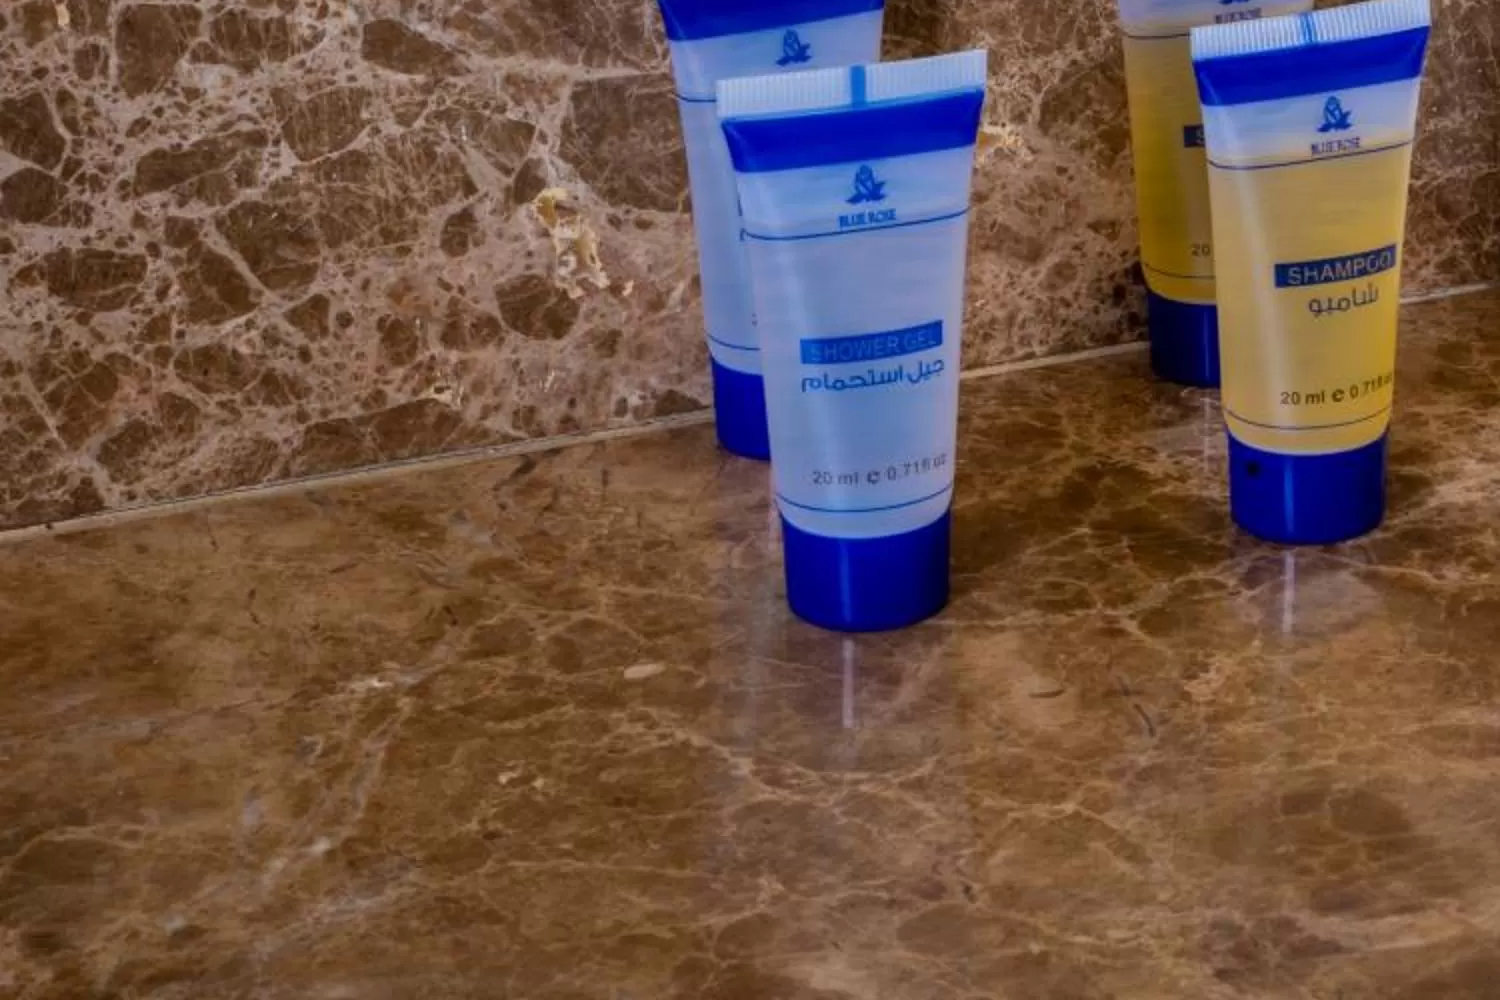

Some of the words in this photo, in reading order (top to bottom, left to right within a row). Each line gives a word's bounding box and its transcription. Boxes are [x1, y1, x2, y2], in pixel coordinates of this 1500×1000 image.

[1288, 251, 1392, 285] SHAMPOO
[811, 336, 900, 362] SHOWER
[903, 328, 937, 350] GEL
[802, 365, 903, 393] استحمام
[1280, 391, 1301, 405] 20
[1304, 389, 1325, 405] ml
[812, 470, 832, 486] 20
[838, 471, 859, 485] ml
